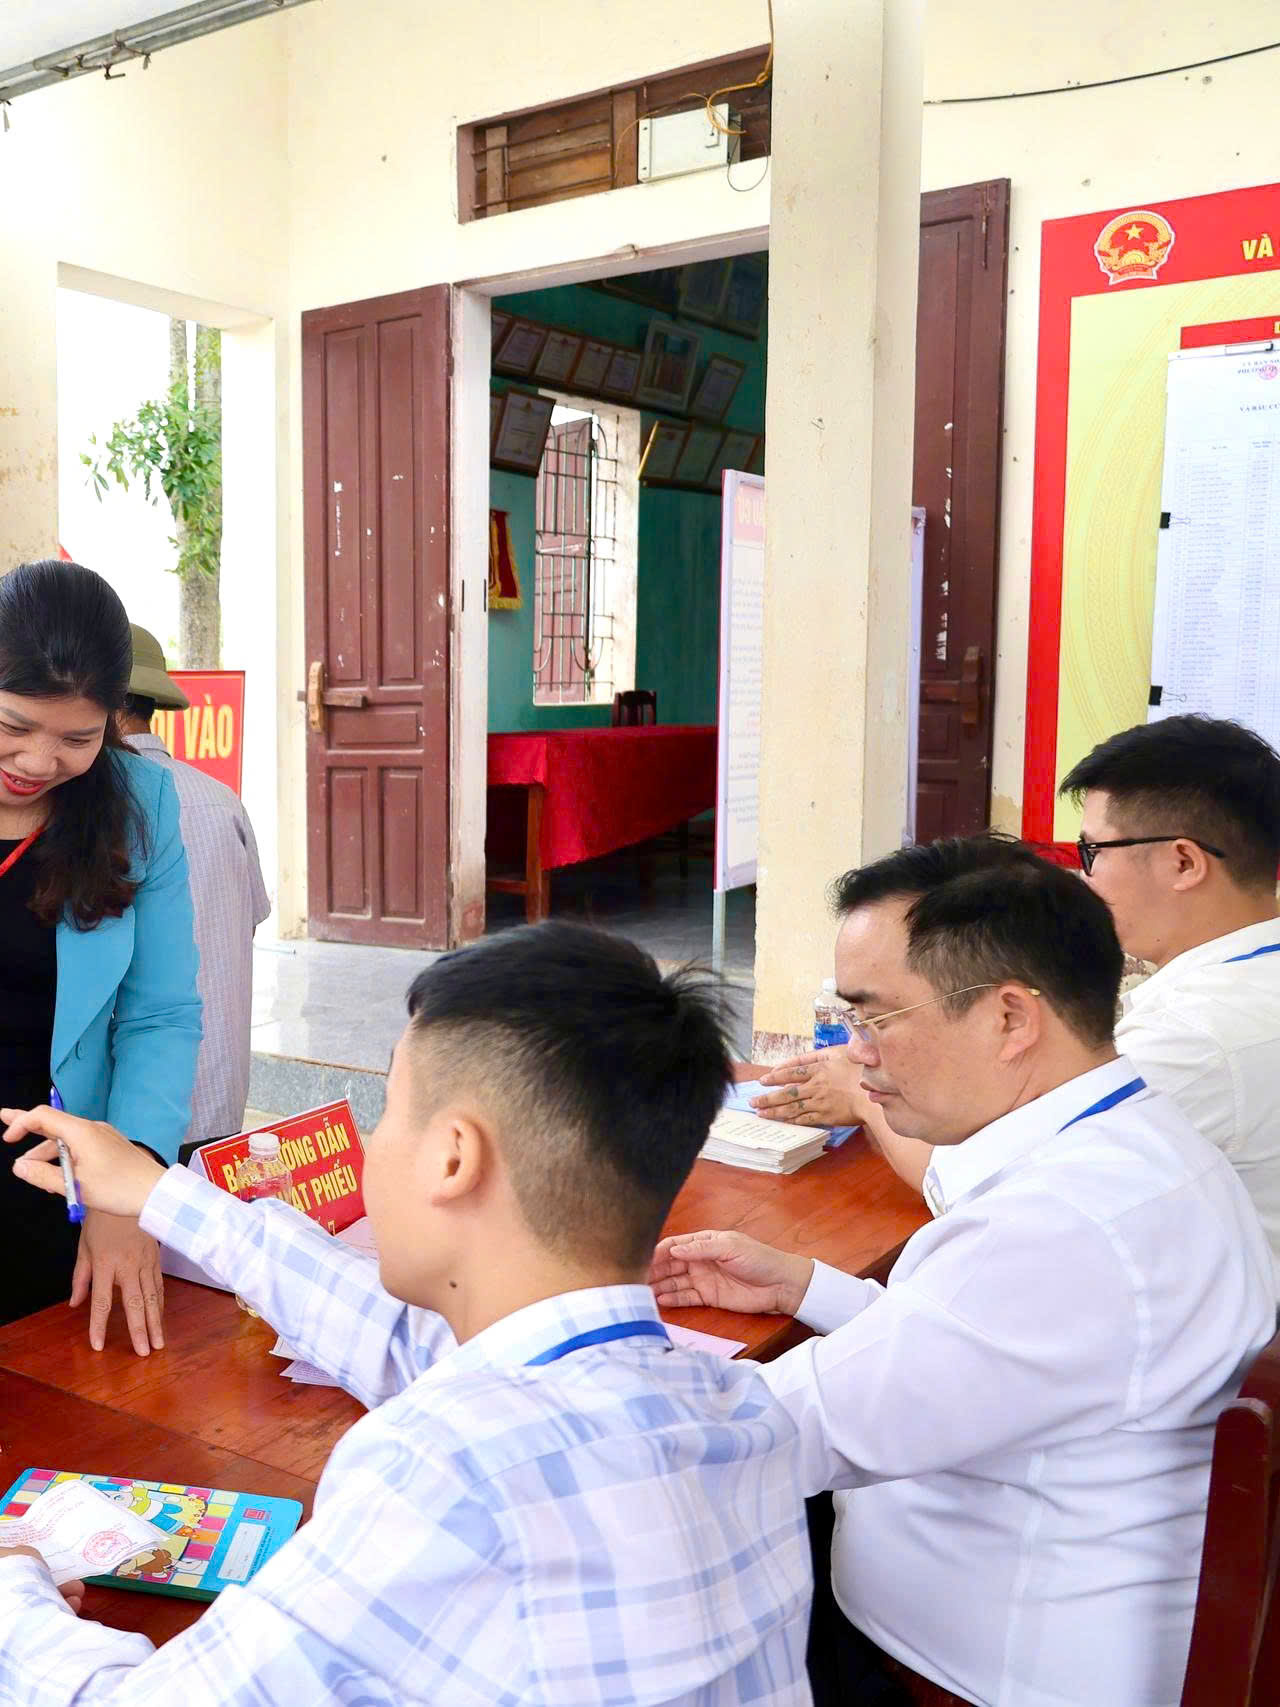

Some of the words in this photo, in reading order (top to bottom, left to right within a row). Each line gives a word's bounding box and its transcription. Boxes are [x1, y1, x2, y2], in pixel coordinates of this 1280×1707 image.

[1242, 233, 1273, 260] VÀ
[183, 693, 234, 760] VÀO
[315, 1117, 351, 1159] DẪN
[310, 1159, 358, 1207] PHIẾU
